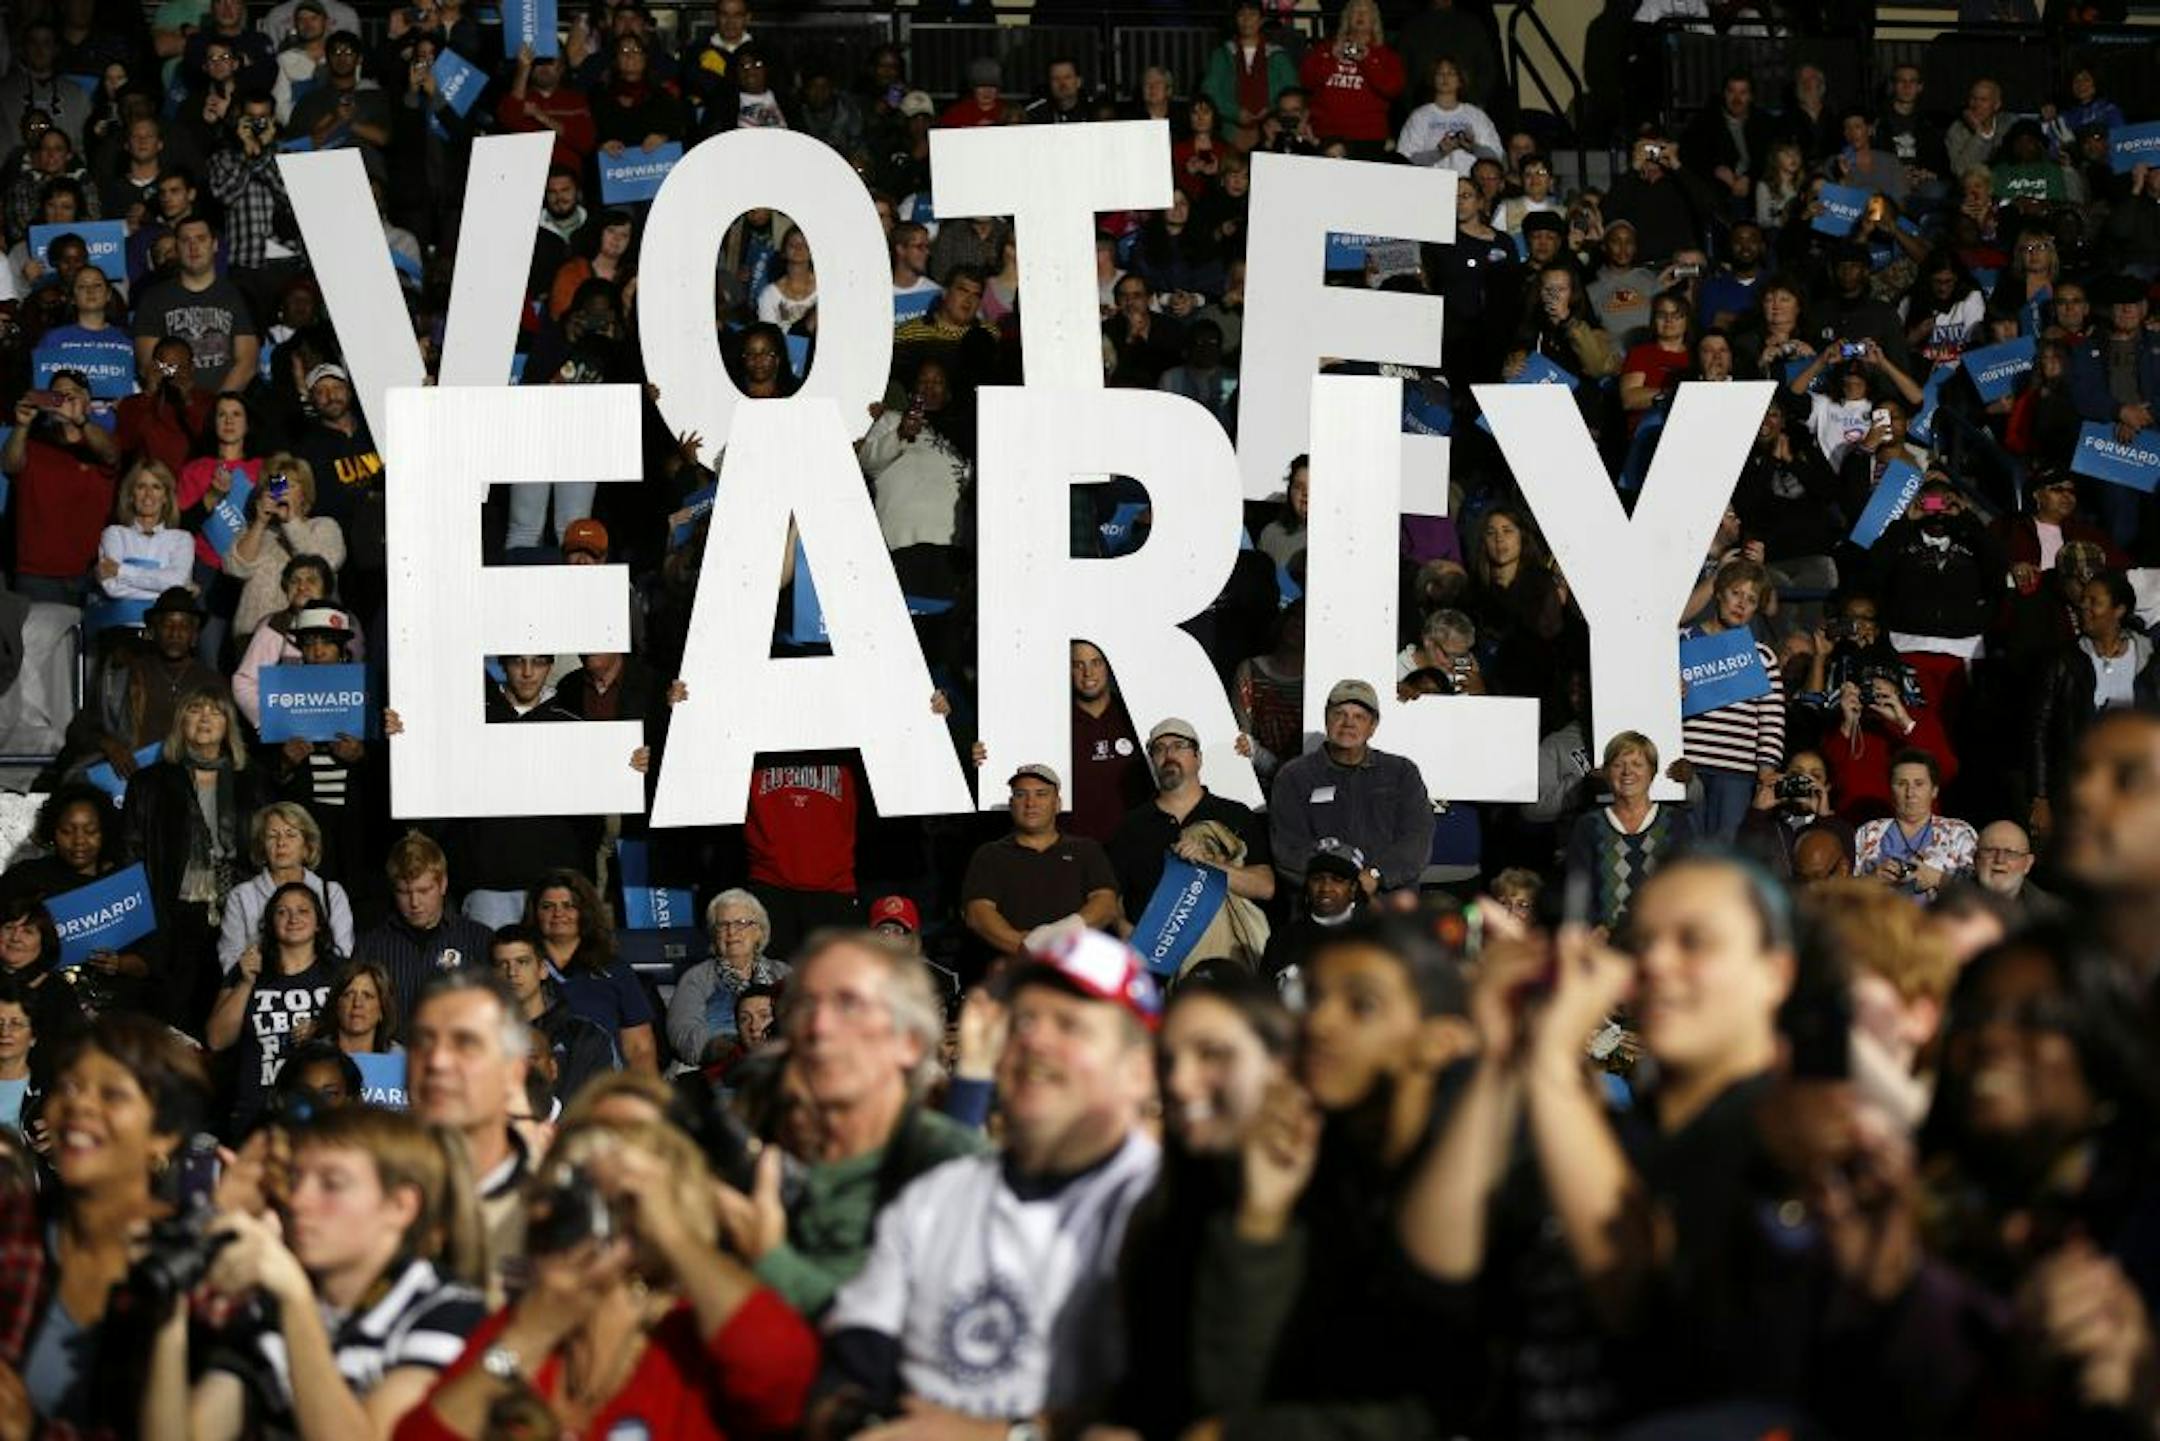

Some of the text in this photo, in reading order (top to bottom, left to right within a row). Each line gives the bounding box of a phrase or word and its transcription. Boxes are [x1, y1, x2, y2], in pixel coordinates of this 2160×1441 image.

[2083, 434, 2160, 468] FORWARD
[385, 374, 1775, 827] EARLY
[1681, 652, 1755, 684] ORWARD!
[267, 692, 364, 709] FORWARD
[56, 893, 142, 938] ORWARD!
[1153, 867, 1208, 964] FORWARD!
